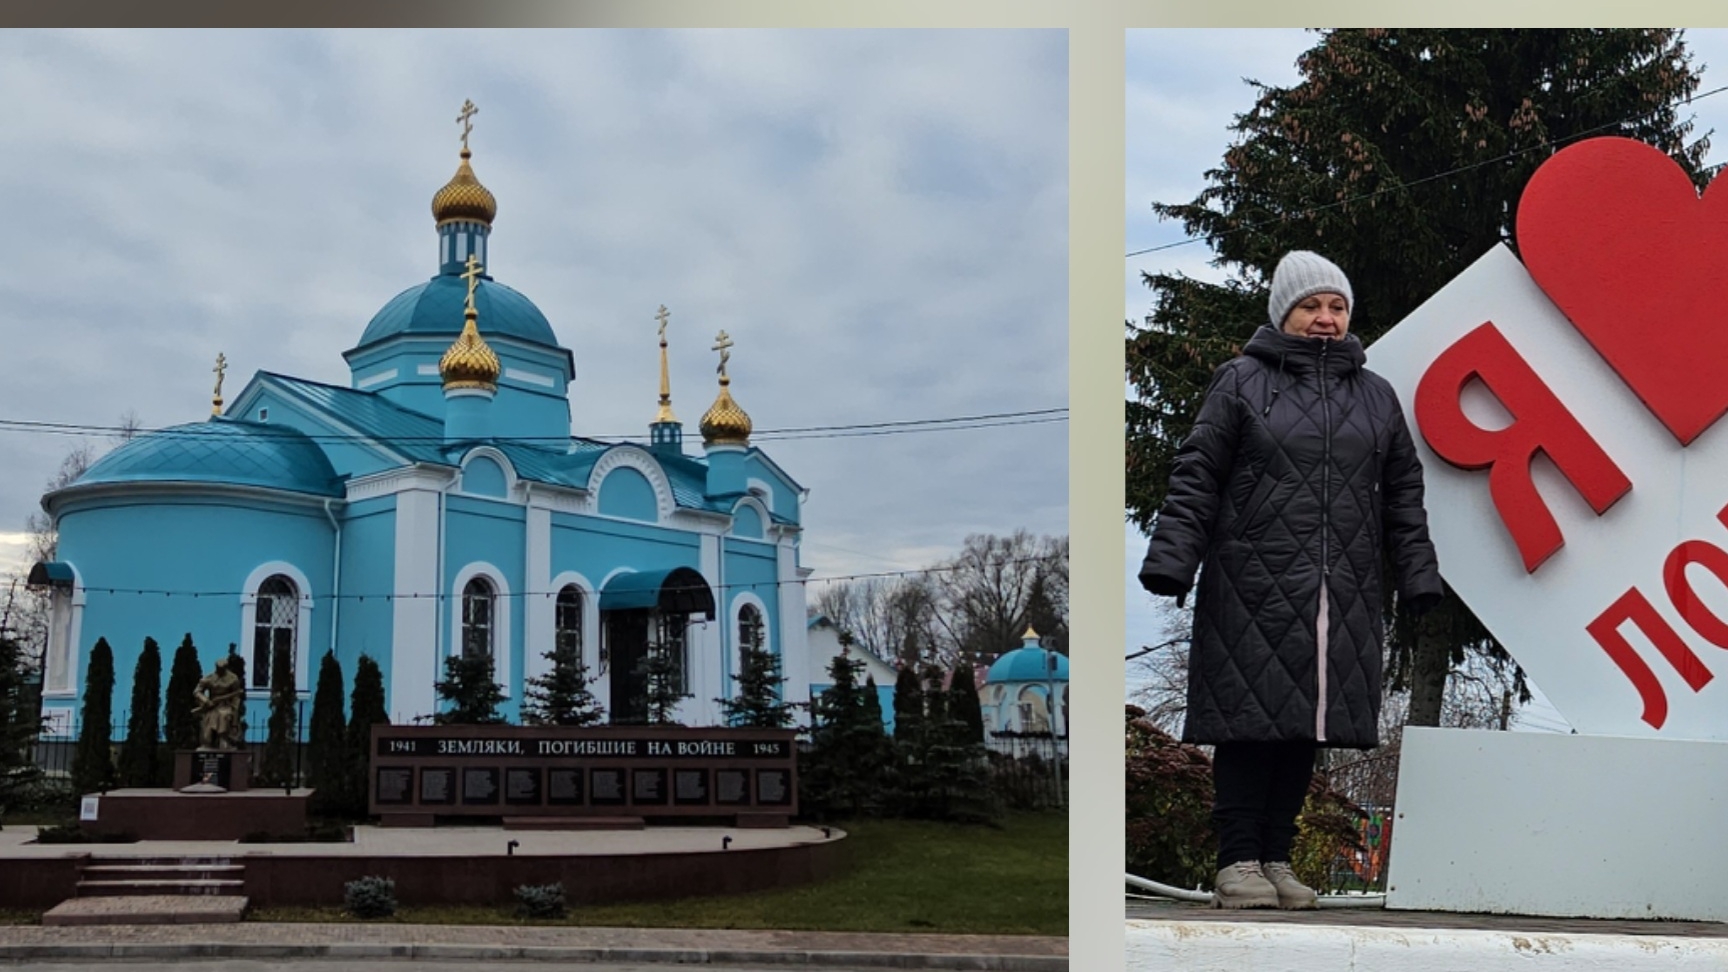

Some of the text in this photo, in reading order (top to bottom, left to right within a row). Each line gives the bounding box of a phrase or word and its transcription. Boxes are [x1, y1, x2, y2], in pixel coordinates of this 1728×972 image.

[1414, 321, 1632, 574] Я
[389, 739, 780, 755] 1941 ЗЕМЛЯКИ, ПОГИБШИЕ НА ВОЙНЕ 1945
